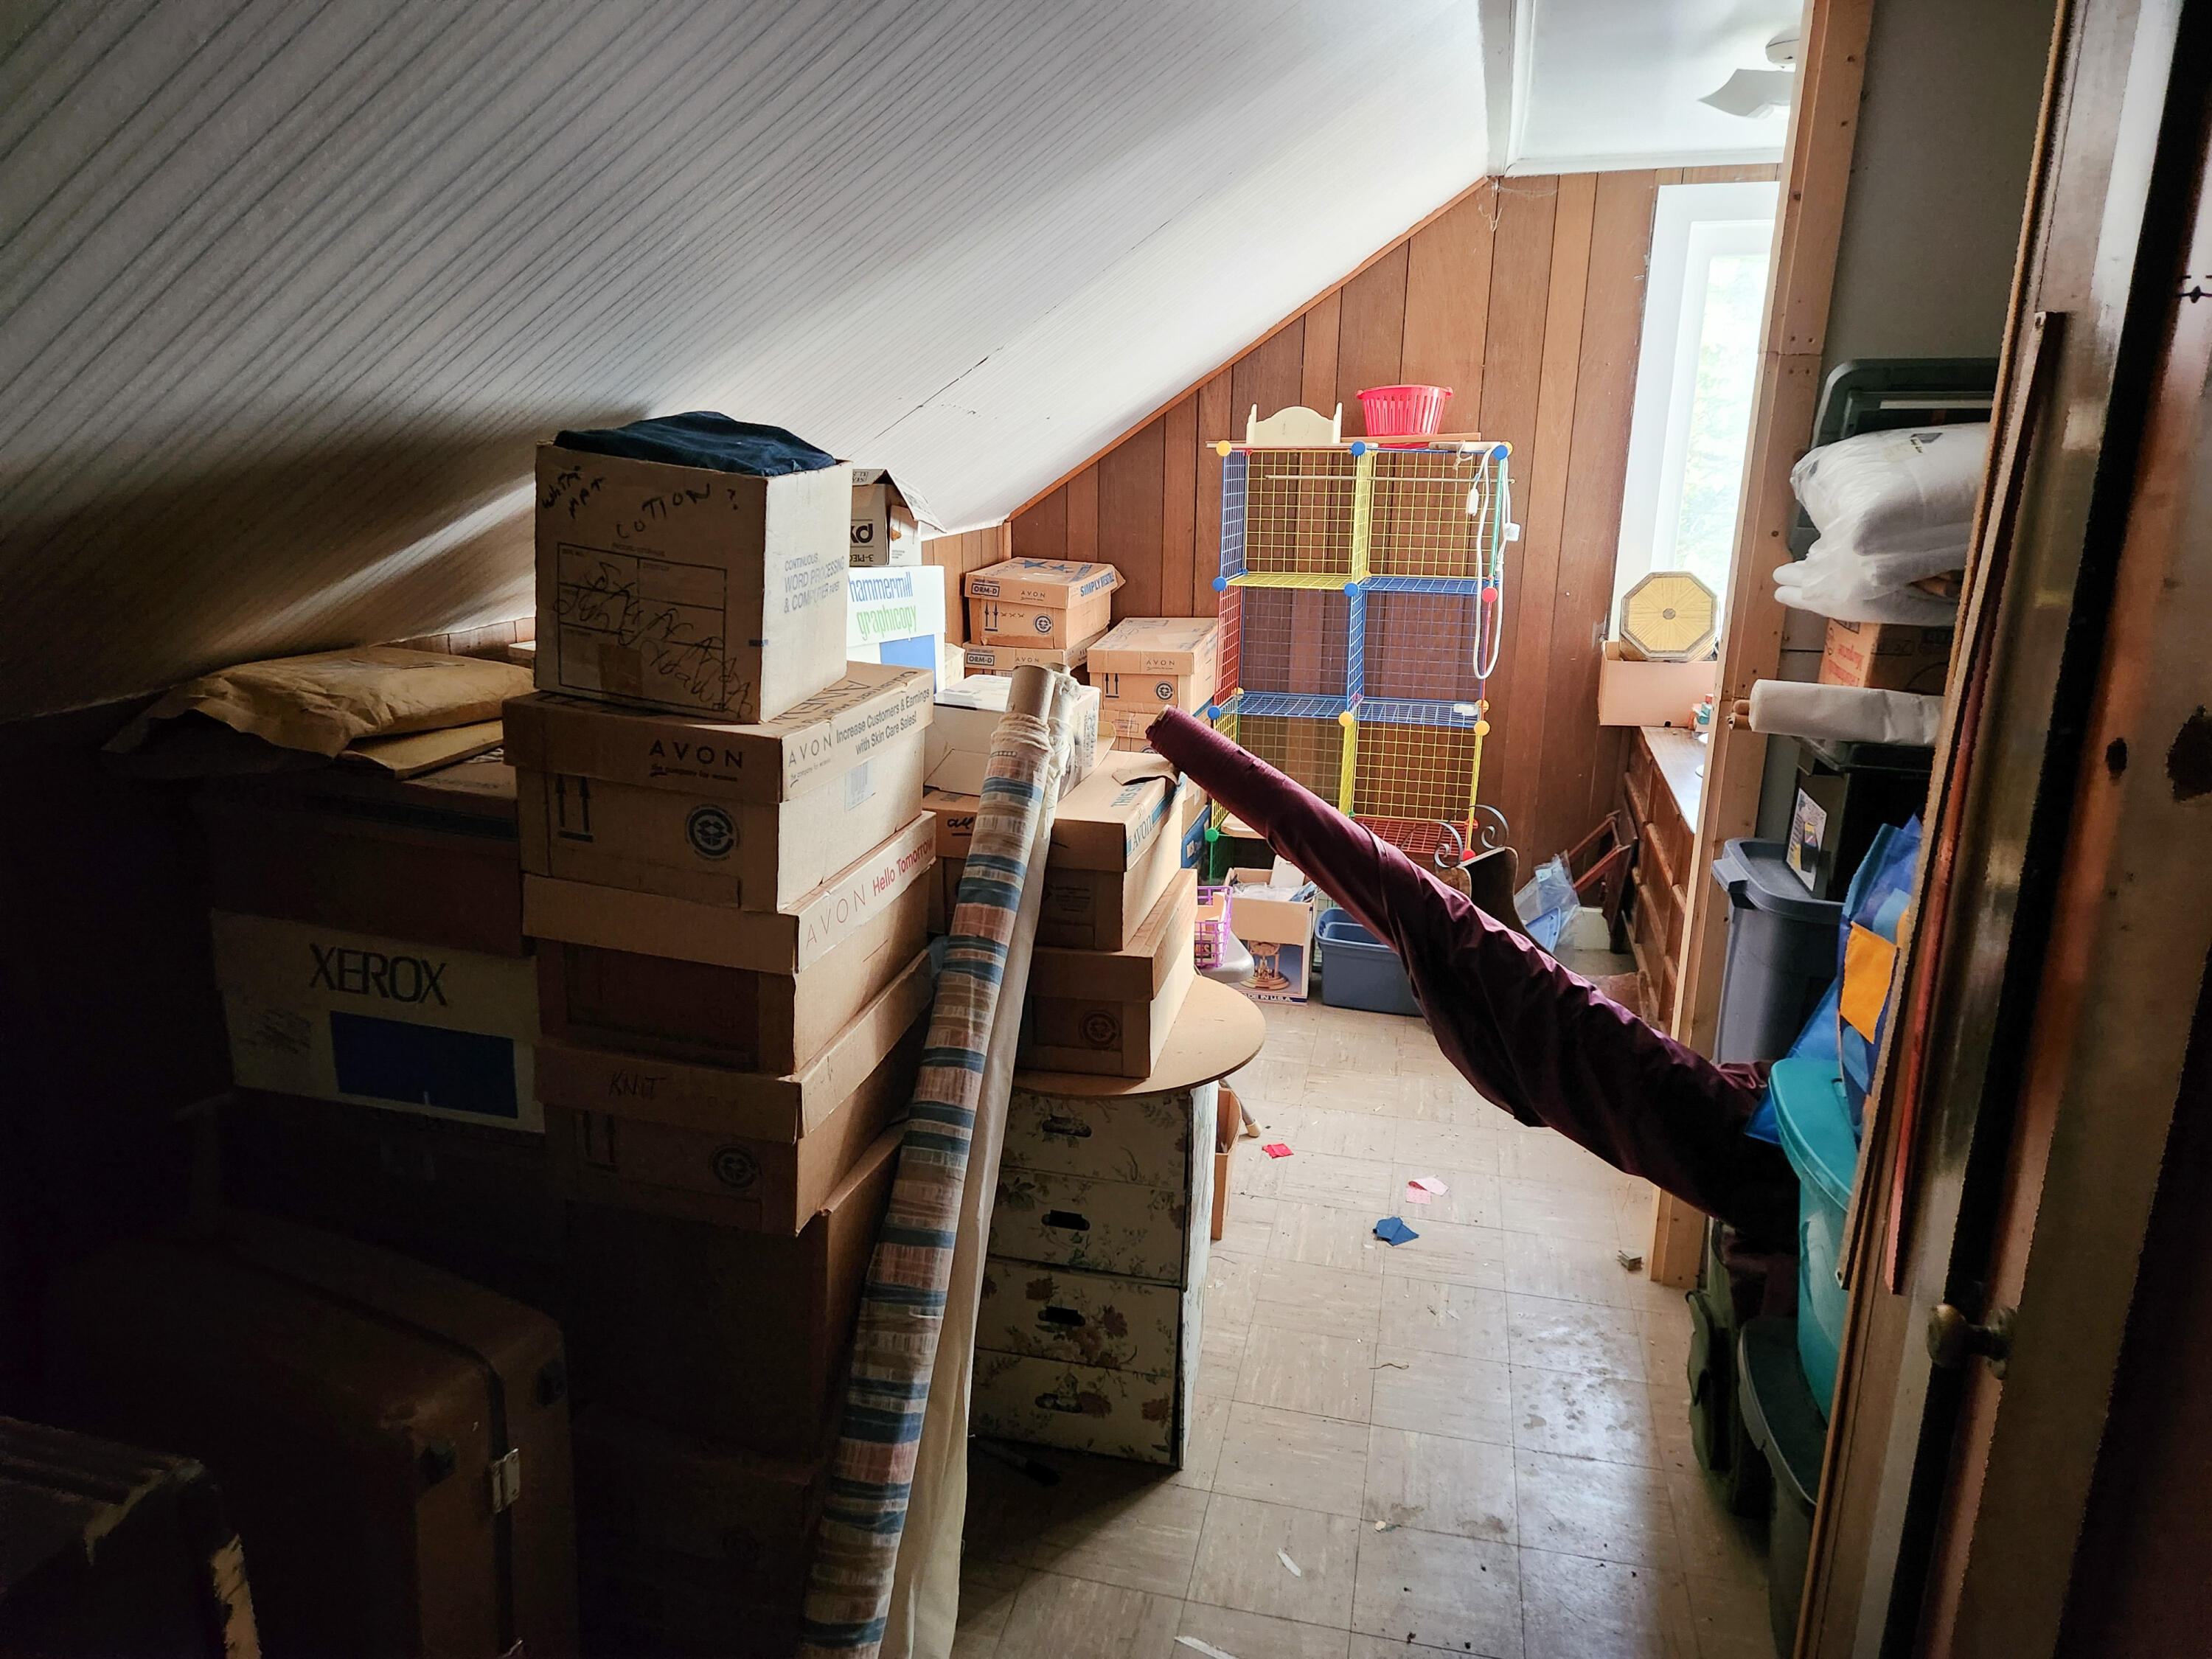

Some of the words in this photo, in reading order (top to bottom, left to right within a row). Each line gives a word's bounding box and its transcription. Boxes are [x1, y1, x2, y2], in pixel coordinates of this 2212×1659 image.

[784, 571, 809, 594] WORD
[848, 571, 914, 602] hammermill
[973, 585, 998, 595] ORM-D
[1020, 590, 1046, 598] AVON
[1080, 577, 1101, 597] SIMPLY
[783, 597, 790, 613] &
[856, 605, 917, 641] graphicopy
[967, 653, 993, 664] ORM-D
[788, 733, 832, 768] AVON
[835, 720, 866, 745] Increase
[866, 706, 900, 729] Customers
[900, 698, 906, 712] &
[905, 688, 931, 710] Earnings
[855, 740, 872, 756] with
[871, 730, 886, 747] Skin
[885, 723, 900, 739] Care
[900, 711, 917, 731] Sales!
[648, 739, 742, 769] AVON
[1110, 792, 1138, 807] THIS
[806, 884, 866, 950] AVON
[872, 866, 896, 897] Hello
[896, 835, 934, 877] Tomorrow
[310, 942, 448, 1006] XEROX
